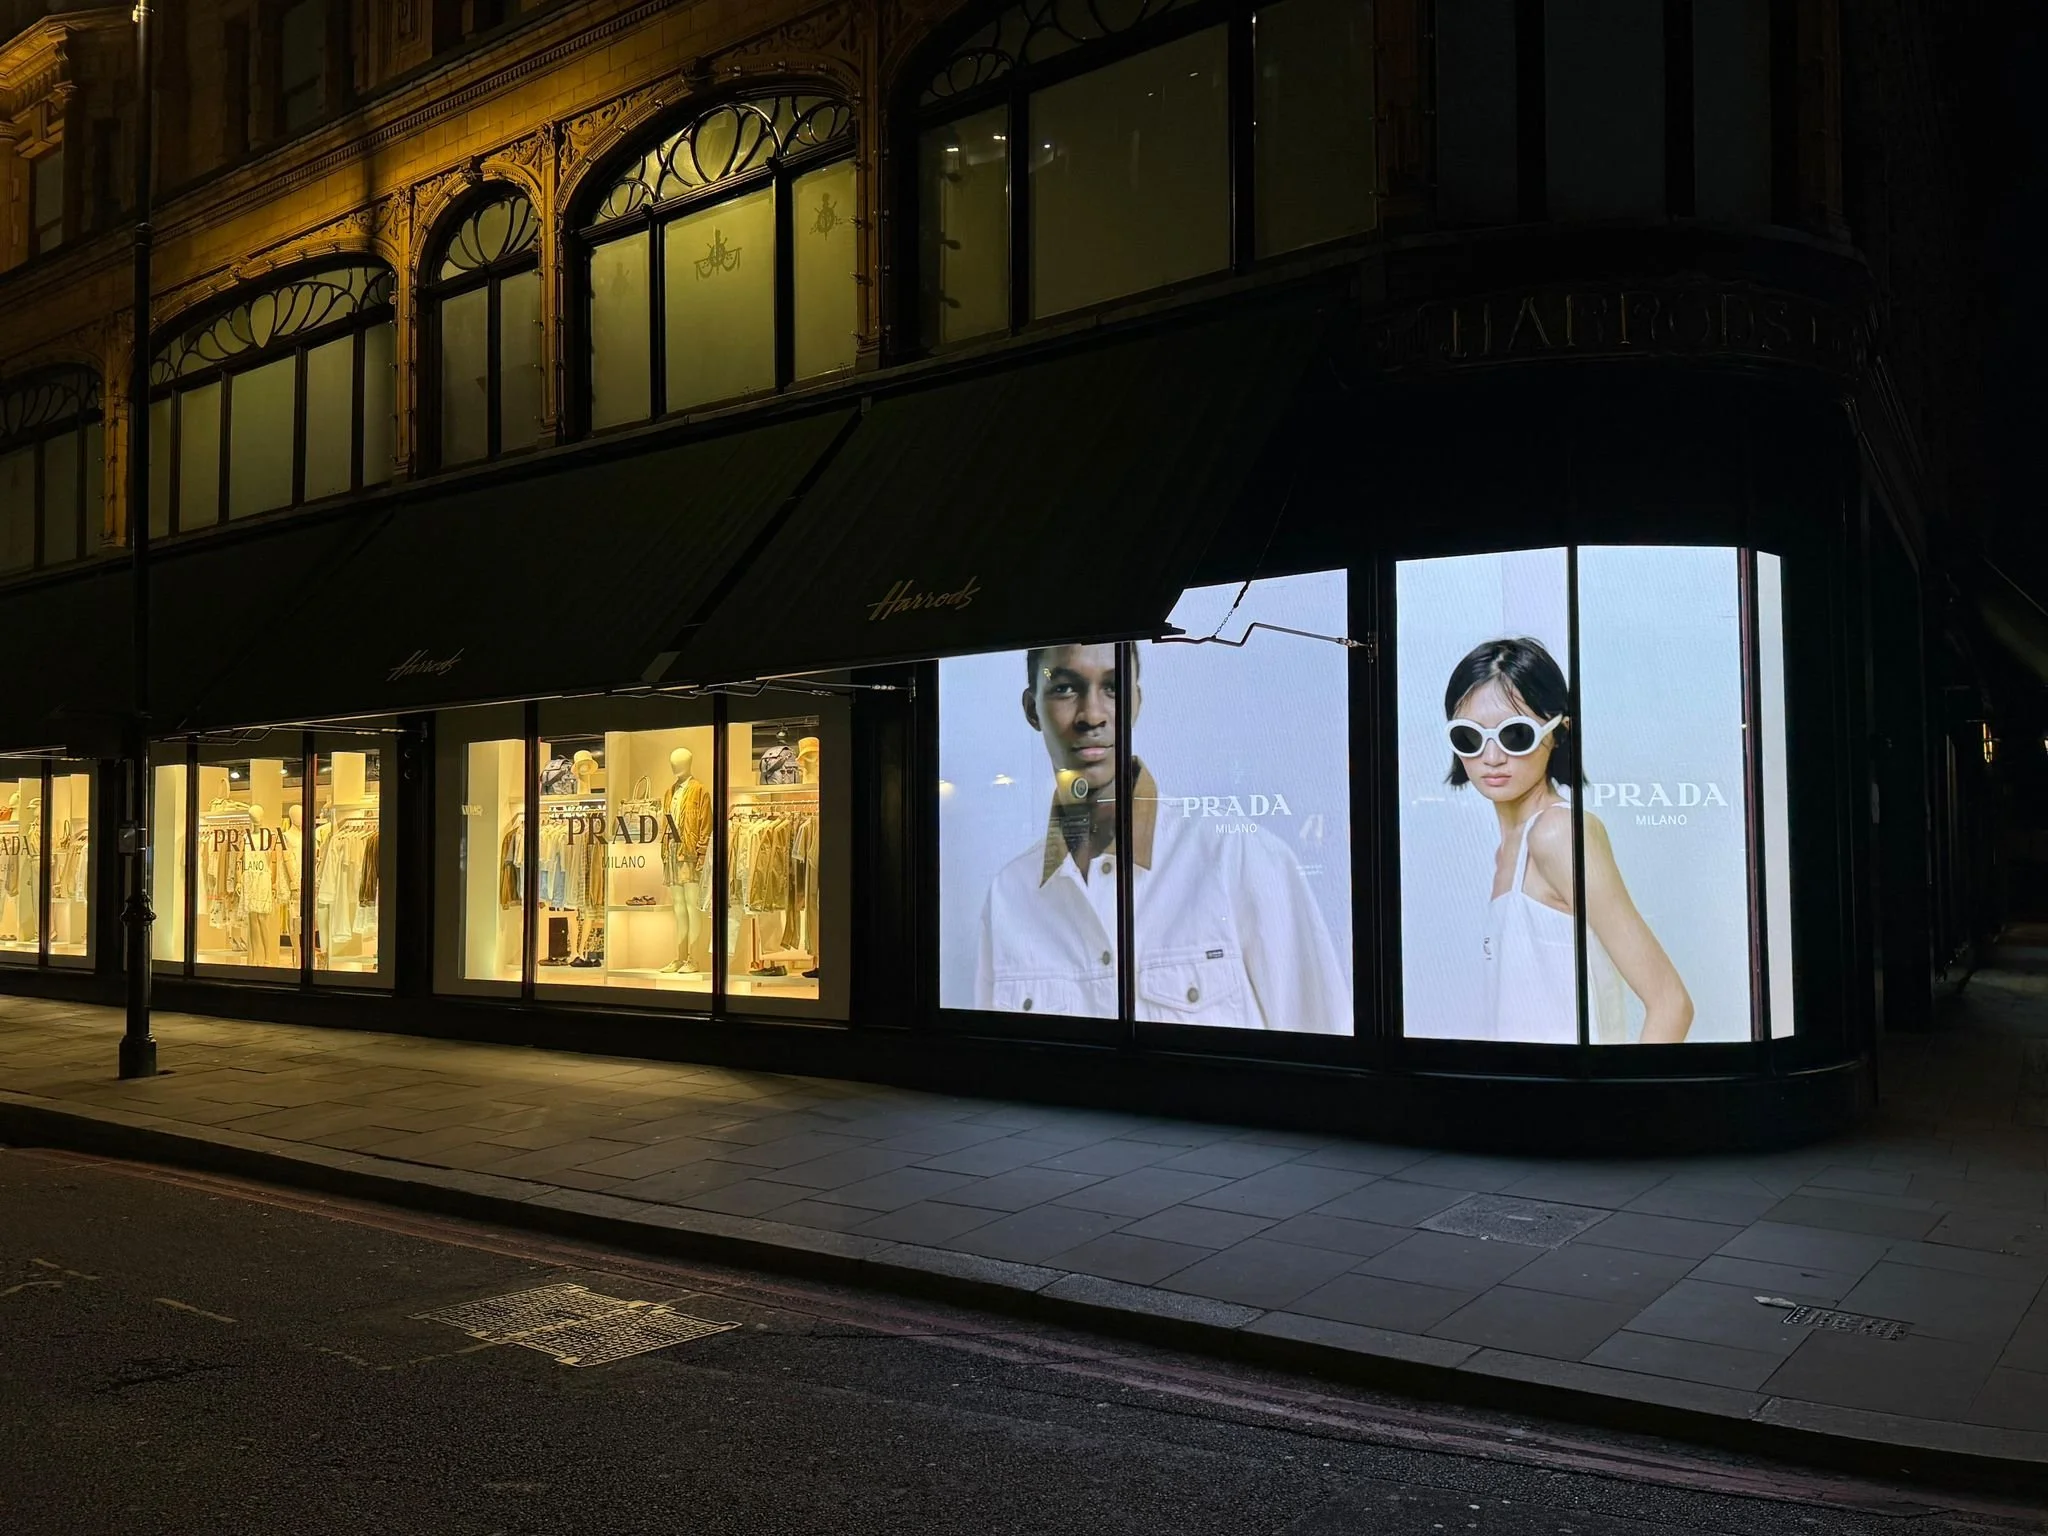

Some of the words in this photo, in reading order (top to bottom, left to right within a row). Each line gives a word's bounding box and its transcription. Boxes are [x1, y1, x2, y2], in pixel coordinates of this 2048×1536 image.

[866, 575, 981, 621] Harrods
[385, 647, 465, 682] Harrods
[1181, 793, 1292, 818] PRADA
[1592, 782, 1729, 807] PRADA
[567, 814, 682, 846] PRADA
[1215, 823, 1257, 835] MILANO
[1635, 814, 1687, 826] MILANO
[213, 827, 288, 853] PRADA
[602, 854, 646, 869] MILANO
